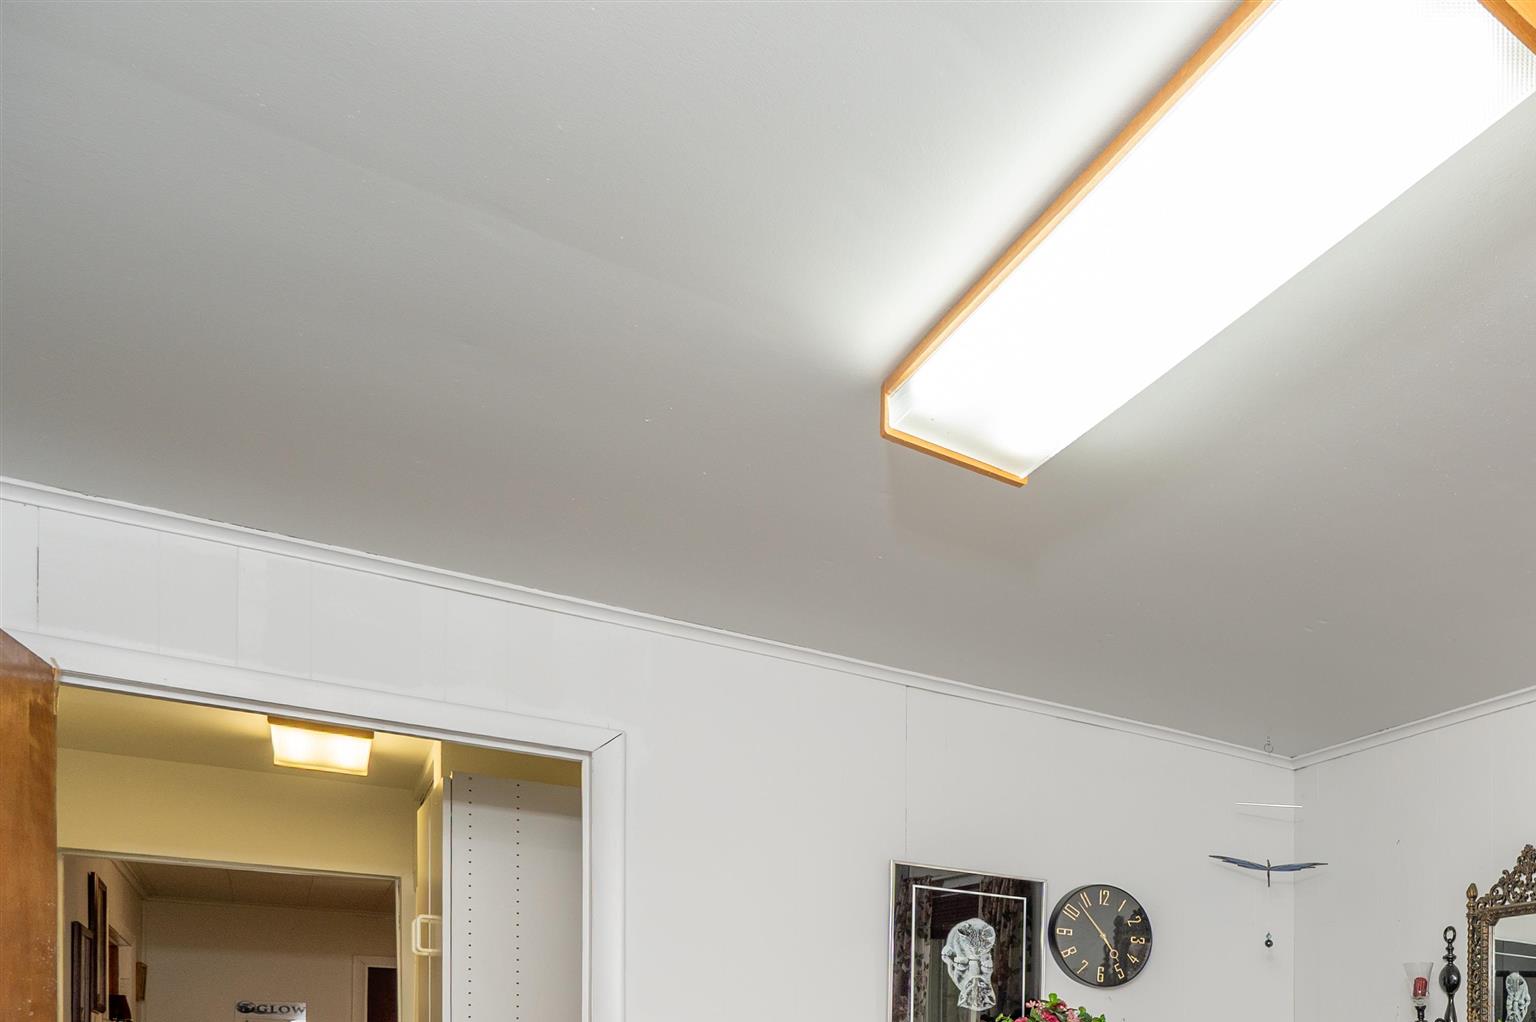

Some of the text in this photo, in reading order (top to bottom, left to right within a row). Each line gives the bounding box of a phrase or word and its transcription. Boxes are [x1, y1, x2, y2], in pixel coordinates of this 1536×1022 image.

[1080, 891, 1092, 908] 11
[1099, 889, 1110, 906] 12
[1062, 903, 1080, 921] 10
[1117, 899, 1127, 912] 1
[1127, 915, 1142, 927] 2
[1056, 927, 1073, 936] 9
[1130, 936, 1145, 944] 3
[1061, 945, 1077, 958] 8
[1126, 953, 1140, 964] 4
[1076, 959, 1089, 974] 7
[1113, 963, 1125, 980] 5
[1096, 966, 1105, 983] 6
[256, 1004, 305, 1014] GLOW
